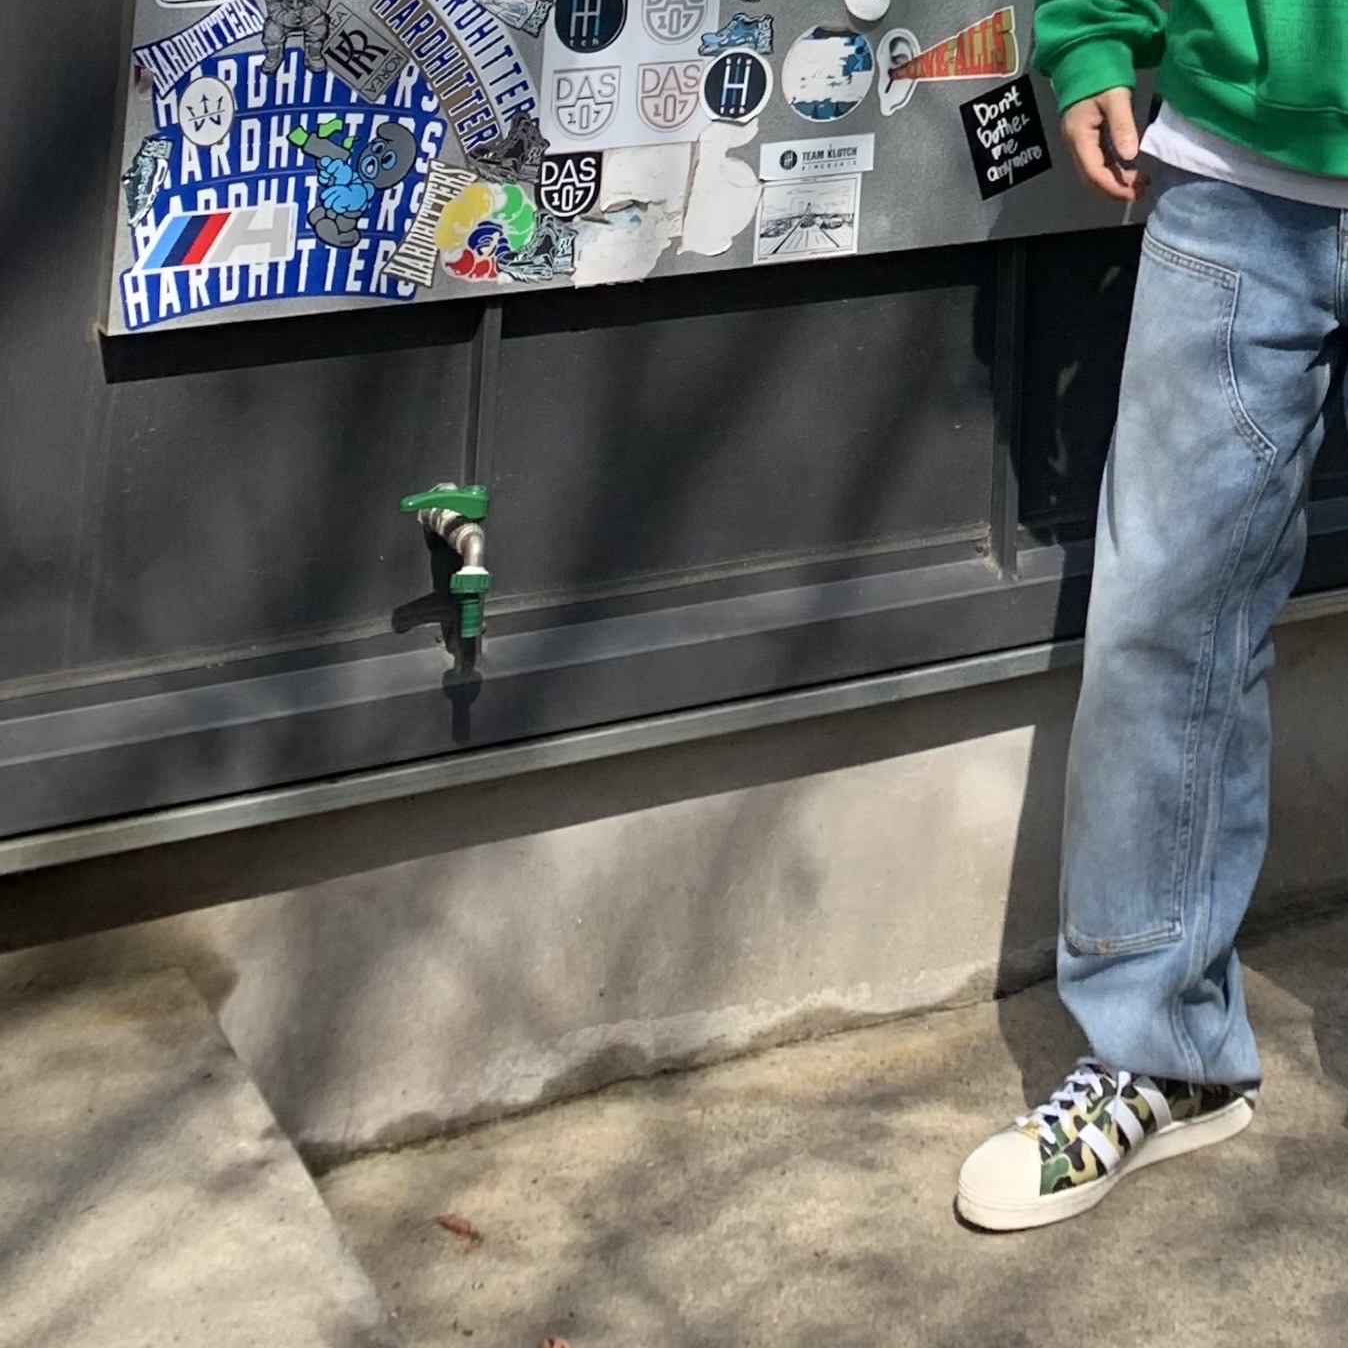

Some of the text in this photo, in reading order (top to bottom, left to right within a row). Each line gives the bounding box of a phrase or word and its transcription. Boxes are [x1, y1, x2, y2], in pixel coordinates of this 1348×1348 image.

[365, 53, 404, 95] KOREA
[557, 73, 617, 102] DAS
[641, 64, 701, 95] DAS
[567, 104, 601, 130] 107
[652, 93, 689, 123] 107
[802, 146, 858, 162] TEAM KLUTCH
[991, 138, 1019, 161] me
[541, 157, 597, 185] DAS
[986, 146, 1043, 186] anymore
[551, 184, 586, 212] 107
